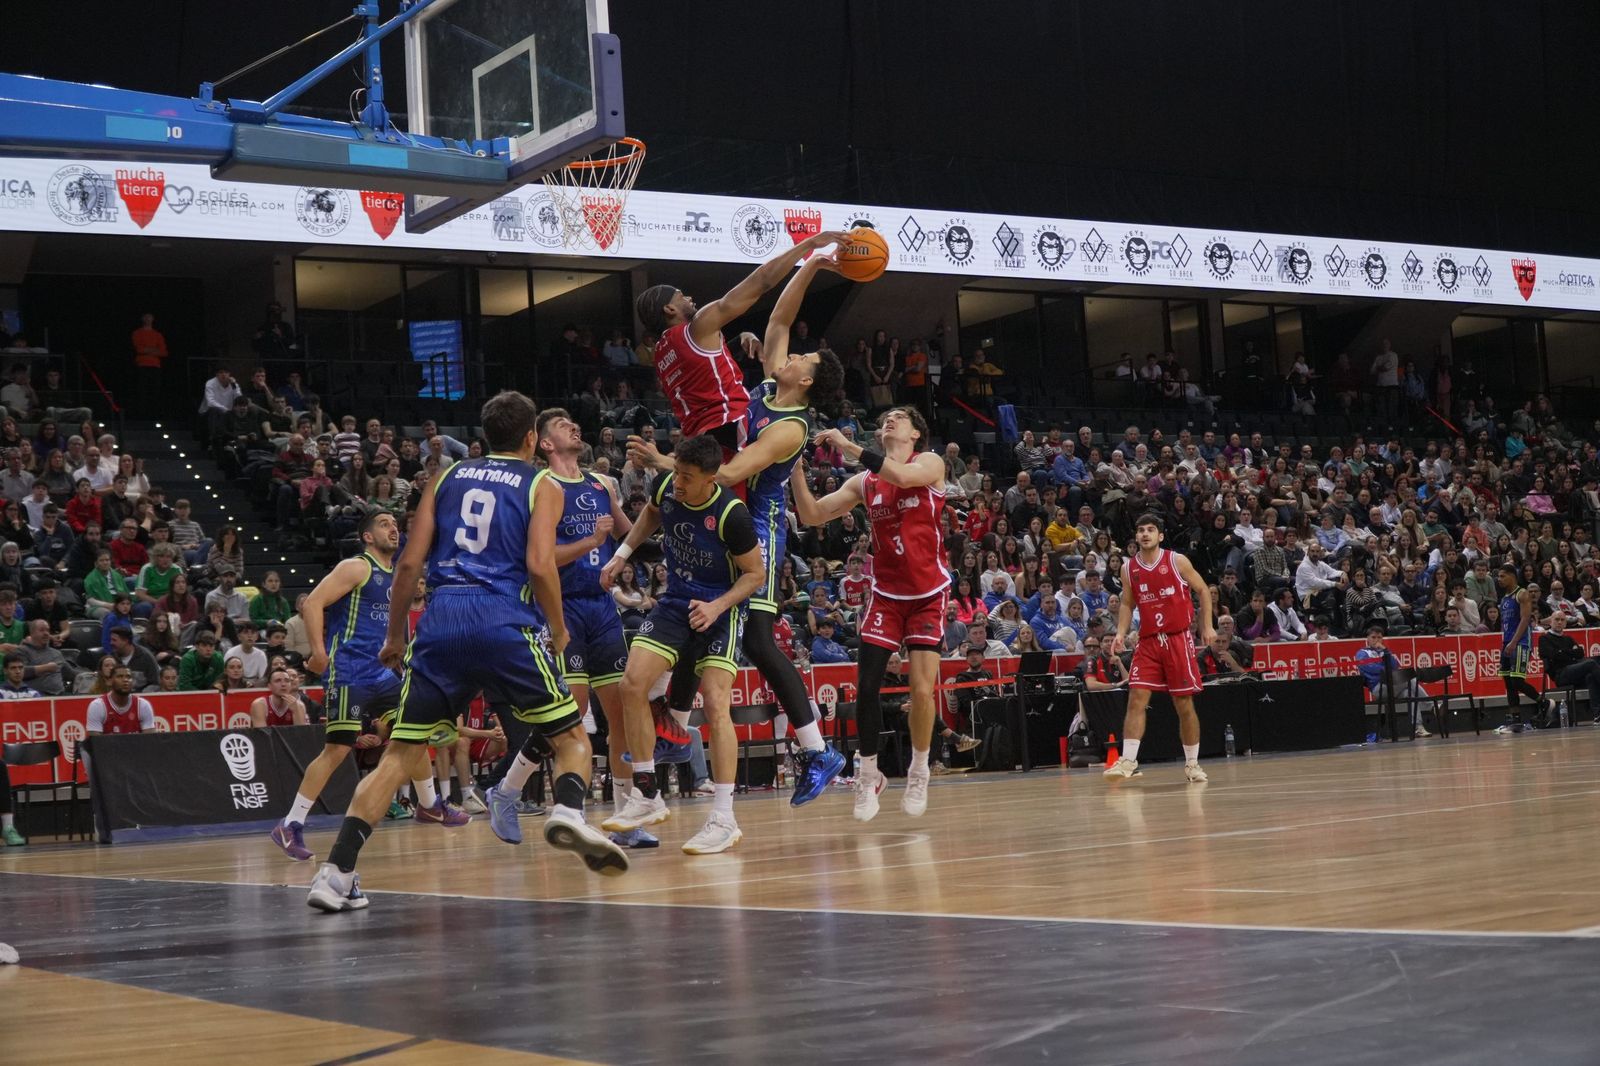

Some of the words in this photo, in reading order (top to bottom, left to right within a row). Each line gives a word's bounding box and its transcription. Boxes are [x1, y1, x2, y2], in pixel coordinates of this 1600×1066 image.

[115, 167, 165, 180] mucha
[123, 182, 159, 196] tierra
[784, 207, 821, 219] mucha
[1511, 256, 1536, 267] mucha
[455, 467, 522, 489] SANTANA
[454, 488, 497, 555] 9
[892, 535, 905, 556] 3
[589, 548, 600, 566] 6
[873, 612, 883, 627] 3
[1155, 613, 1164, 627] 2
[1432, 651, 1457, 667] FNB
[1132, 666, 1139, 677] 2
[173, 713, 218, 732] FNB
[2, 720, 49, 741] FNB
[230, 782, 268, 797] FNB
[232, 795, 269, 810] NSF
